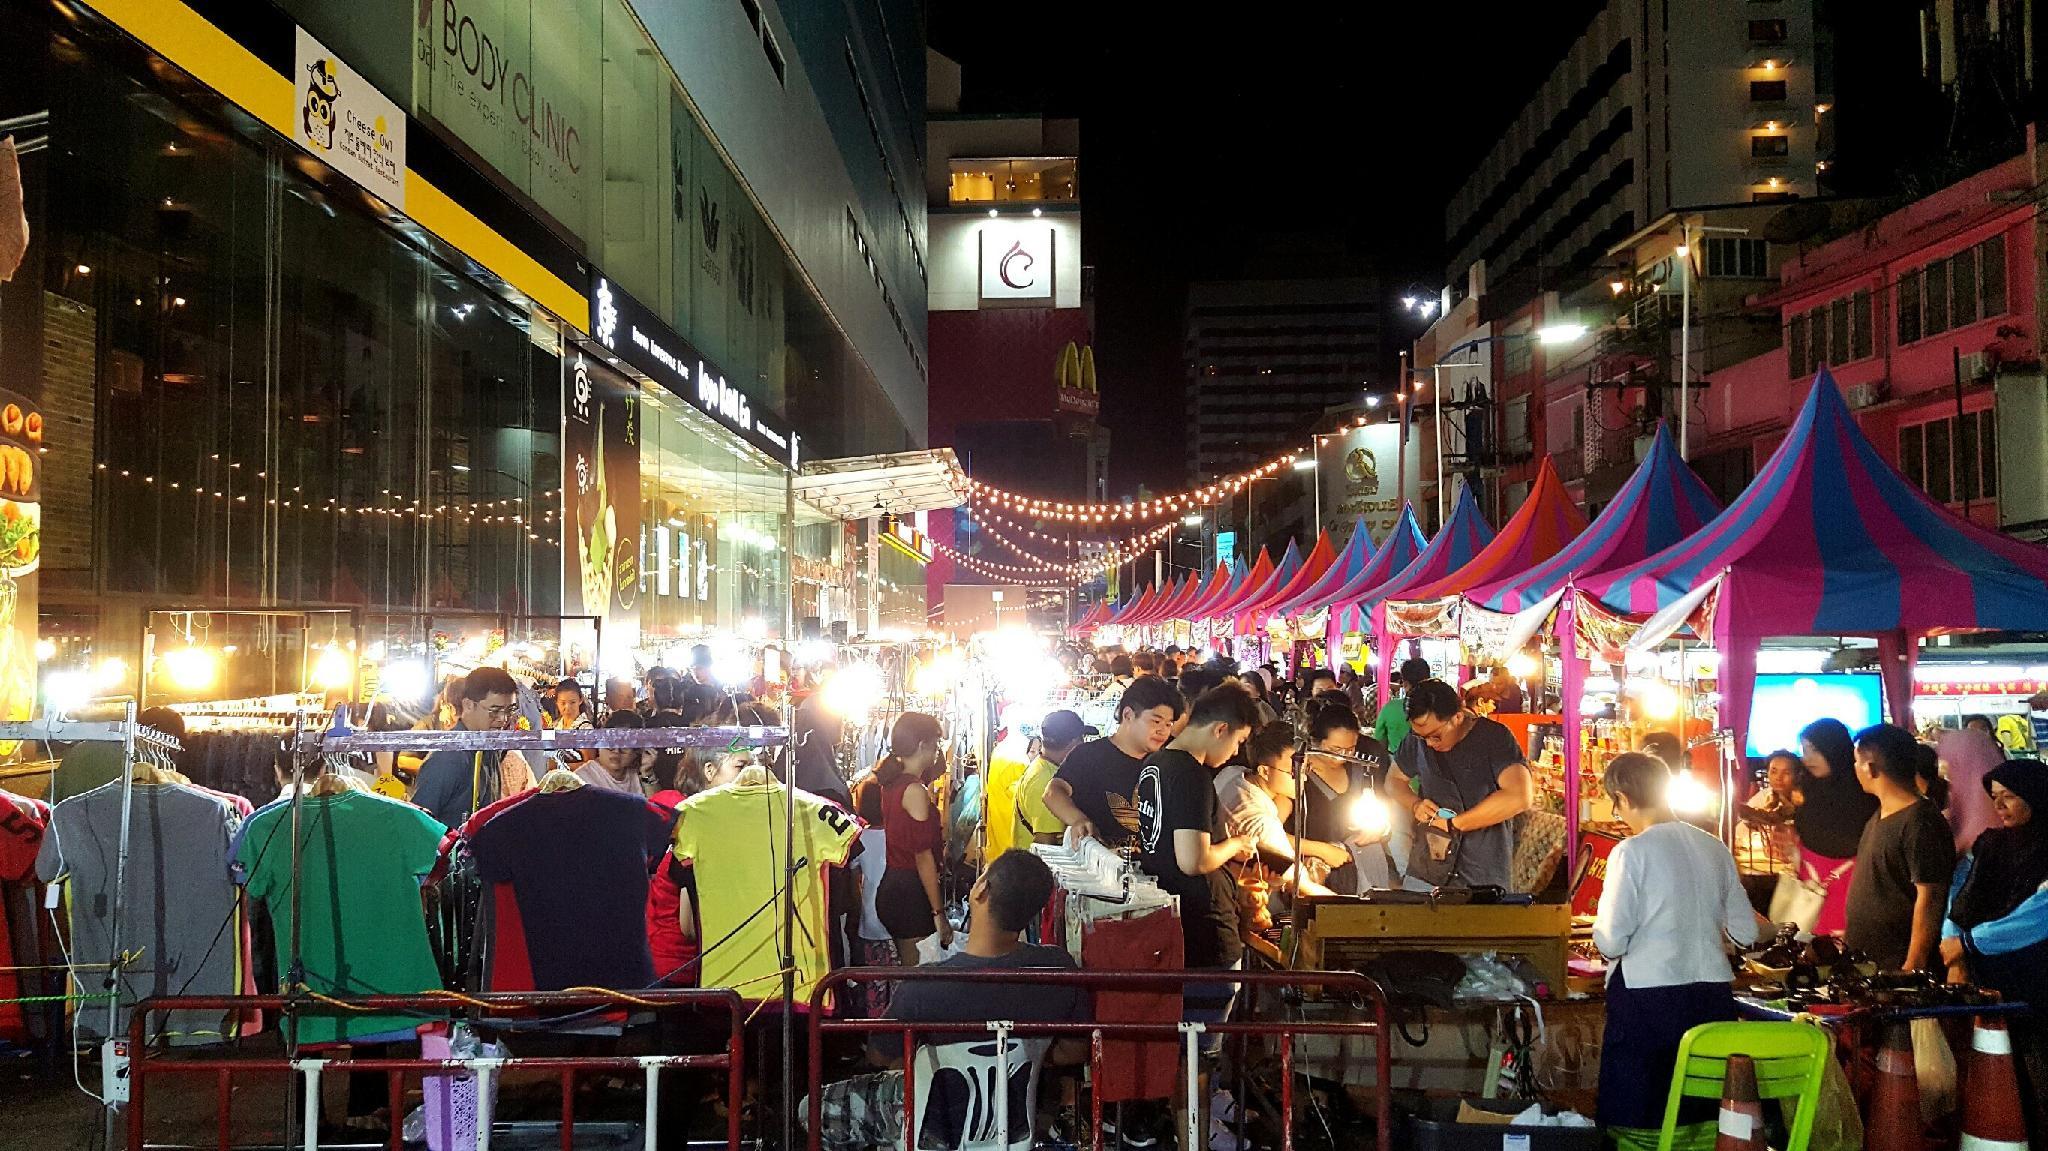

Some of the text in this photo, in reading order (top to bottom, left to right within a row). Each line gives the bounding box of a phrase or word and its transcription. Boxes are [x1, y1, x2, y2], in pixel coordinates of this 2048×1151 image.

[347, 110, 393, 153] Cheese Owl
[443, 0, 581, 174] BODY CLINIC
